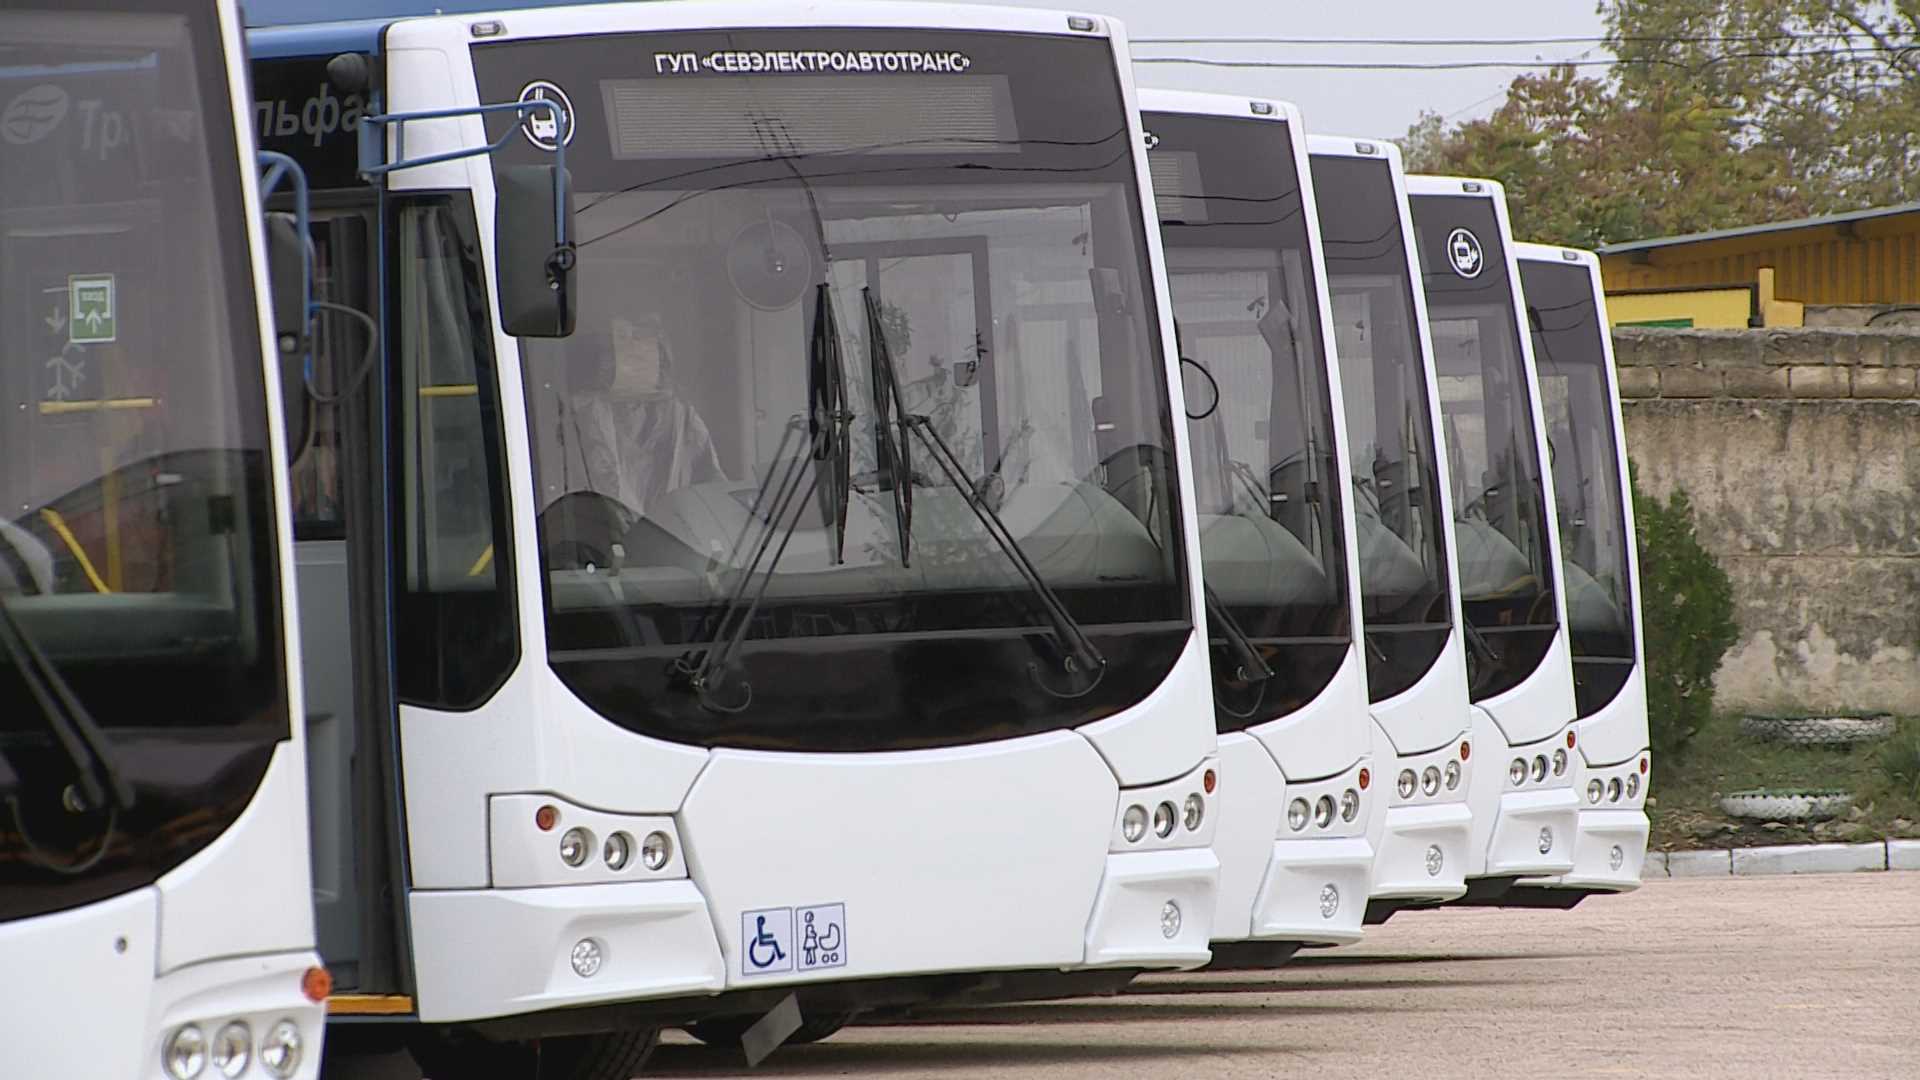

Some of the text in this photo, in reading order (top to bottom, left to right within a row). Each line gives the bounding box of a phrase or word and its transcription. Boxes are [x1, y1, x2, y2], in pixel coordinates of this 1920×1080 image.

[654, 51, 970, 73] ГУП «СЕВЭЛЕКТРОАВТОТРАНС»
[79, 99, 128, 161] Тр
